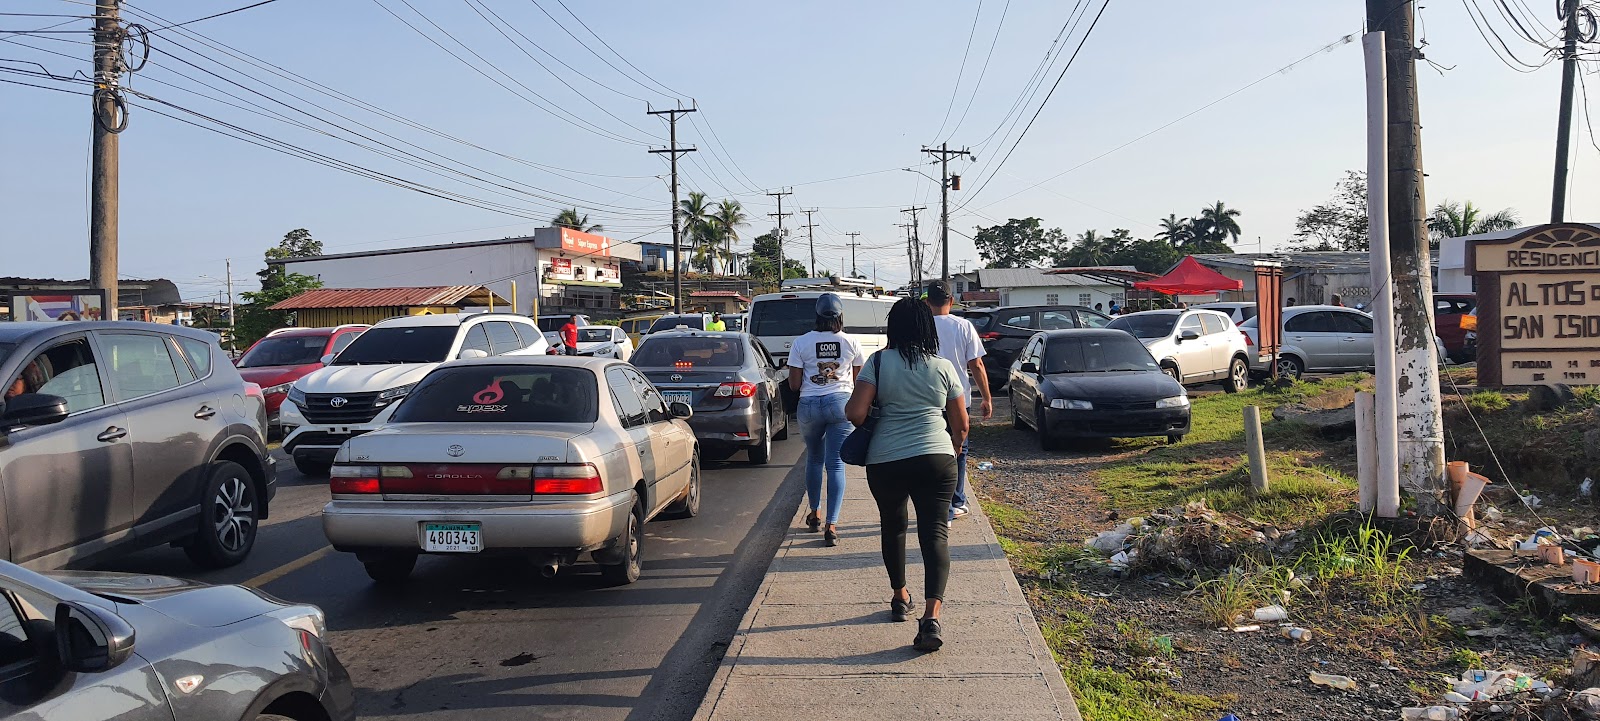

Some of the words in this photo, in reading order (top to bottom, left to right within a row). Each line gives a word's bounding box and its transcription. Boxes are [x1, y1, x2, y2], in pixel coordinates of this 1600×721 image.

[1507, 280, 1586, 306] ALTOS
[1504, 315, 1544, 340] SAN
[820, 344, 837, 352] GOOD
[1512, 361, 1552, 369] FUNDADA
[429, 531, 476, 545] 480343
